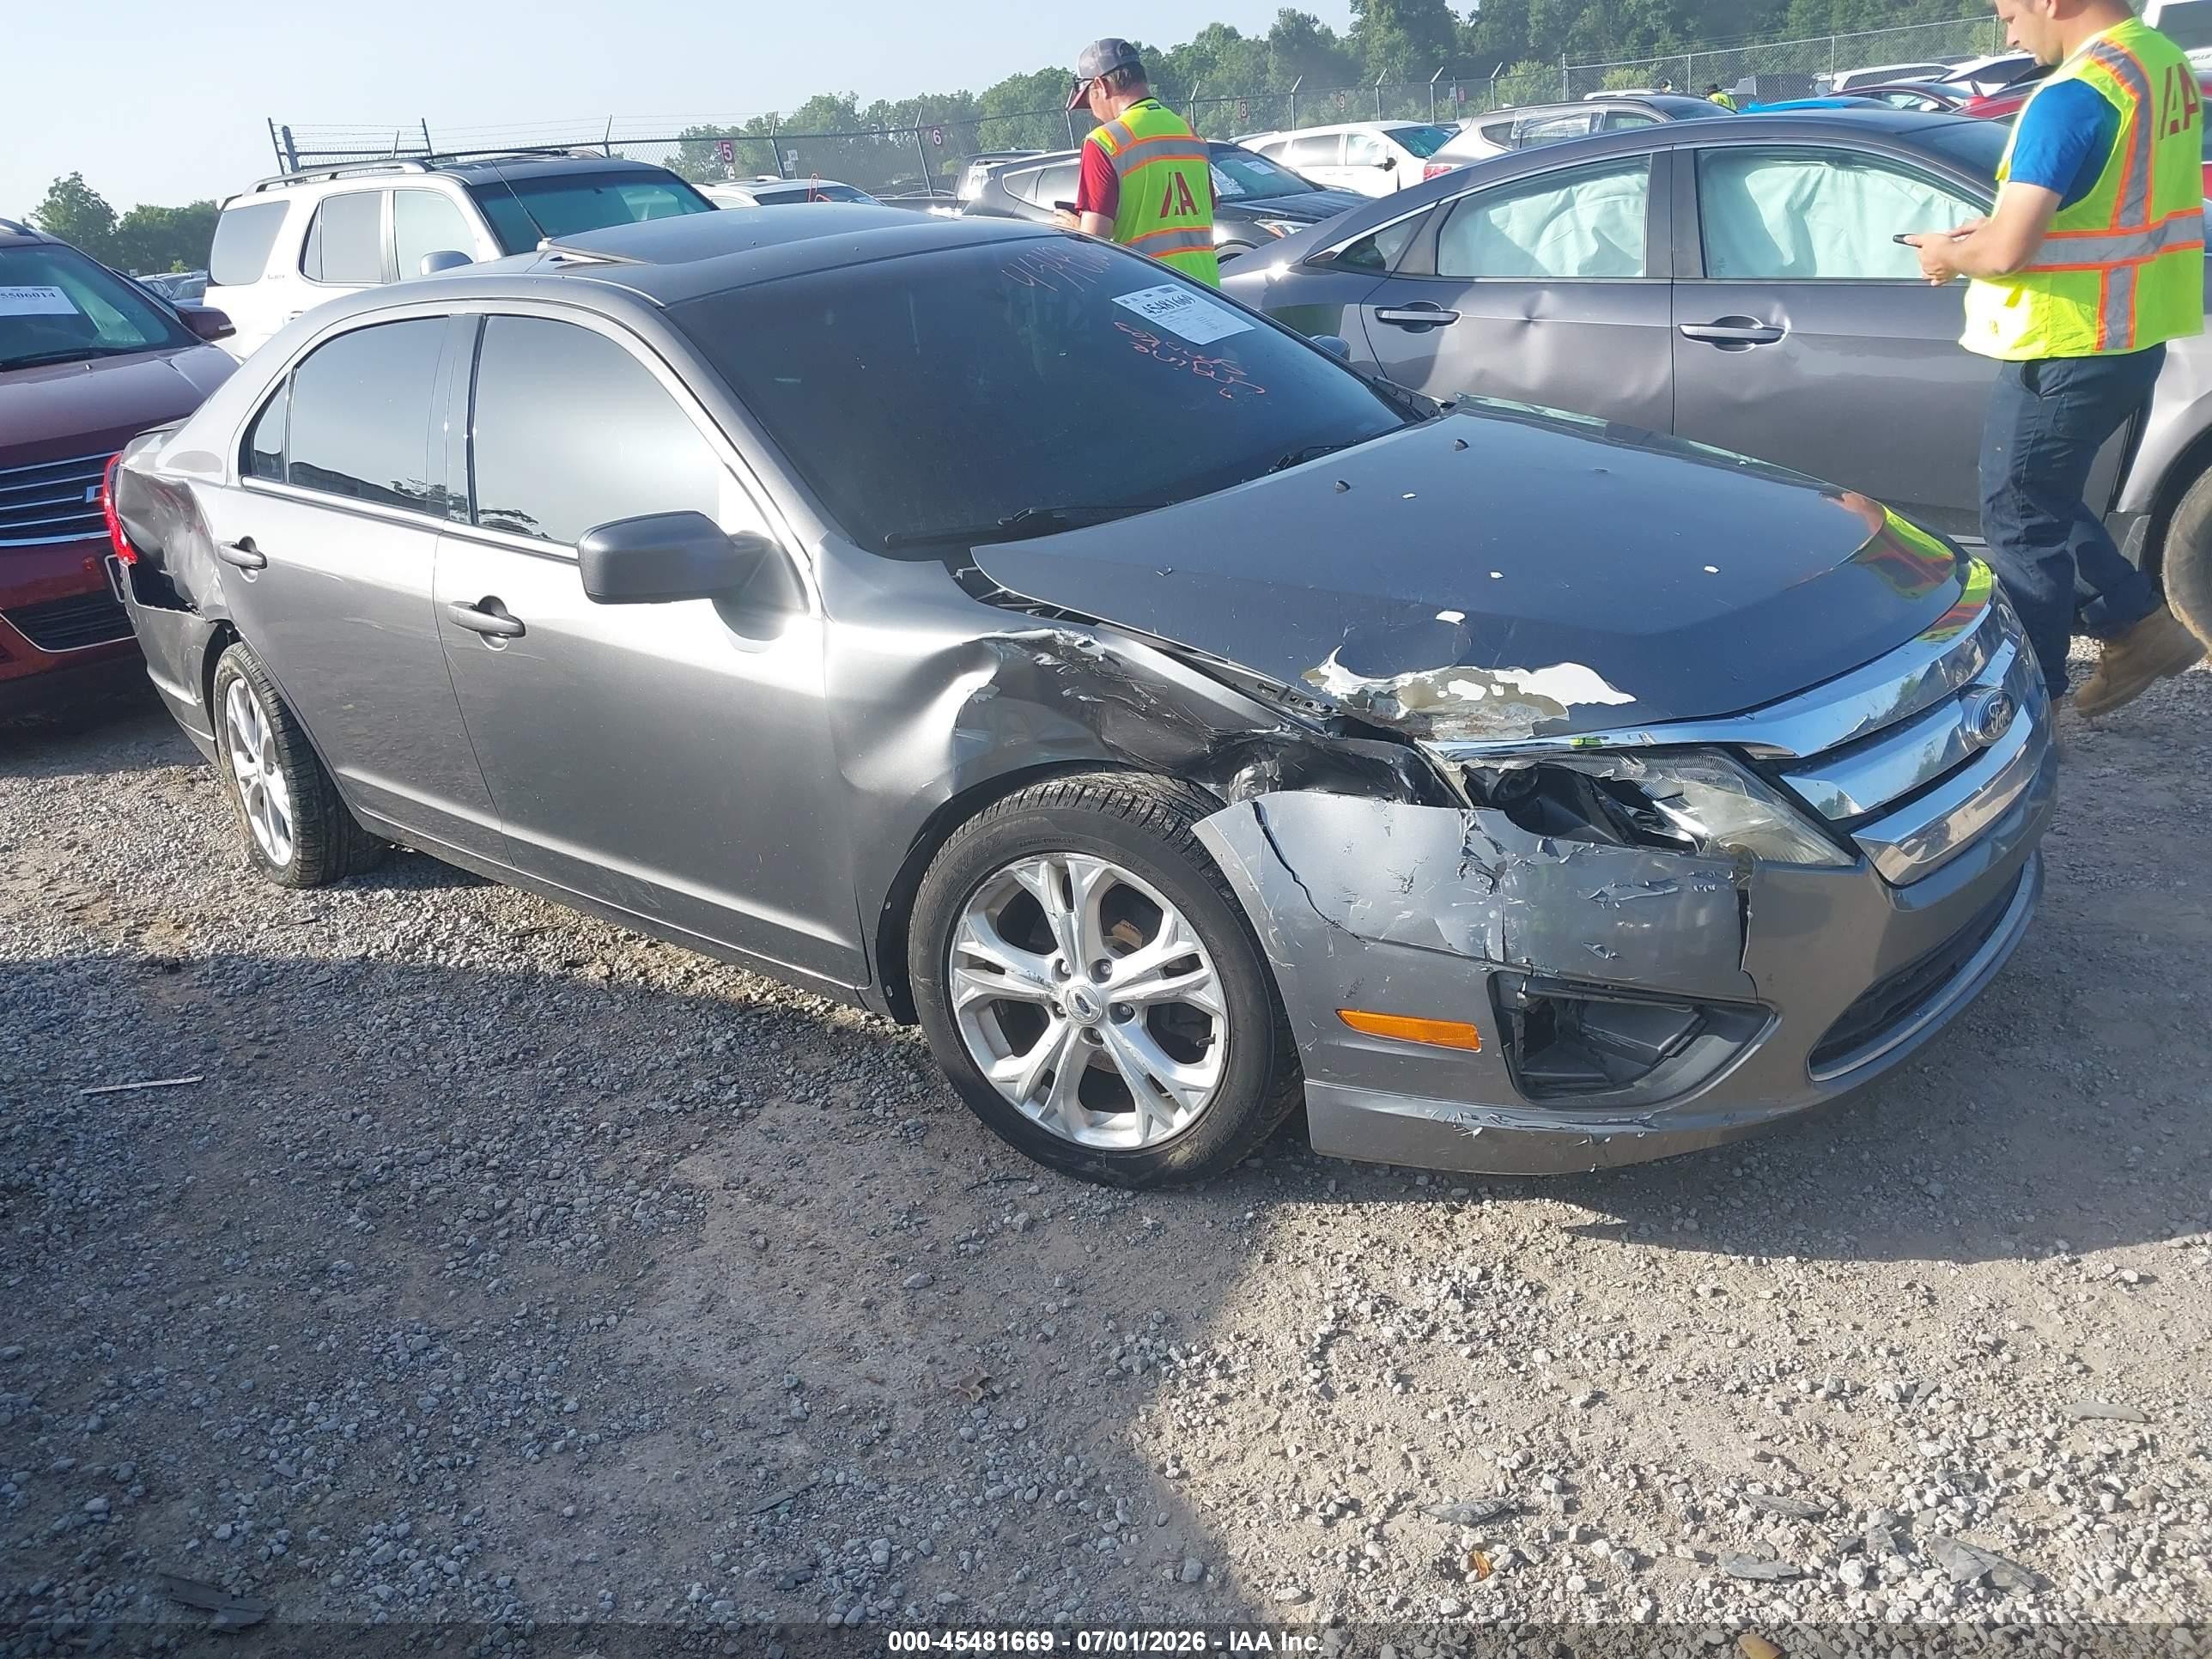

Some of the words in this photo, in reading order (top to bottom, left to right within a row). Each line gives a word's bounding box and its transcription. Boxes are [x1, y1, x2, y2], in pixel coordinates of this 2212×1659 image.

[1241, 102, 1247, 117] 8
[933, 129, 942, 145] 6
[722, 143, 732, 161] 5
[1140, 294, 1197, 315] 45481669
[1988, 696, 2013, 734] Ford
